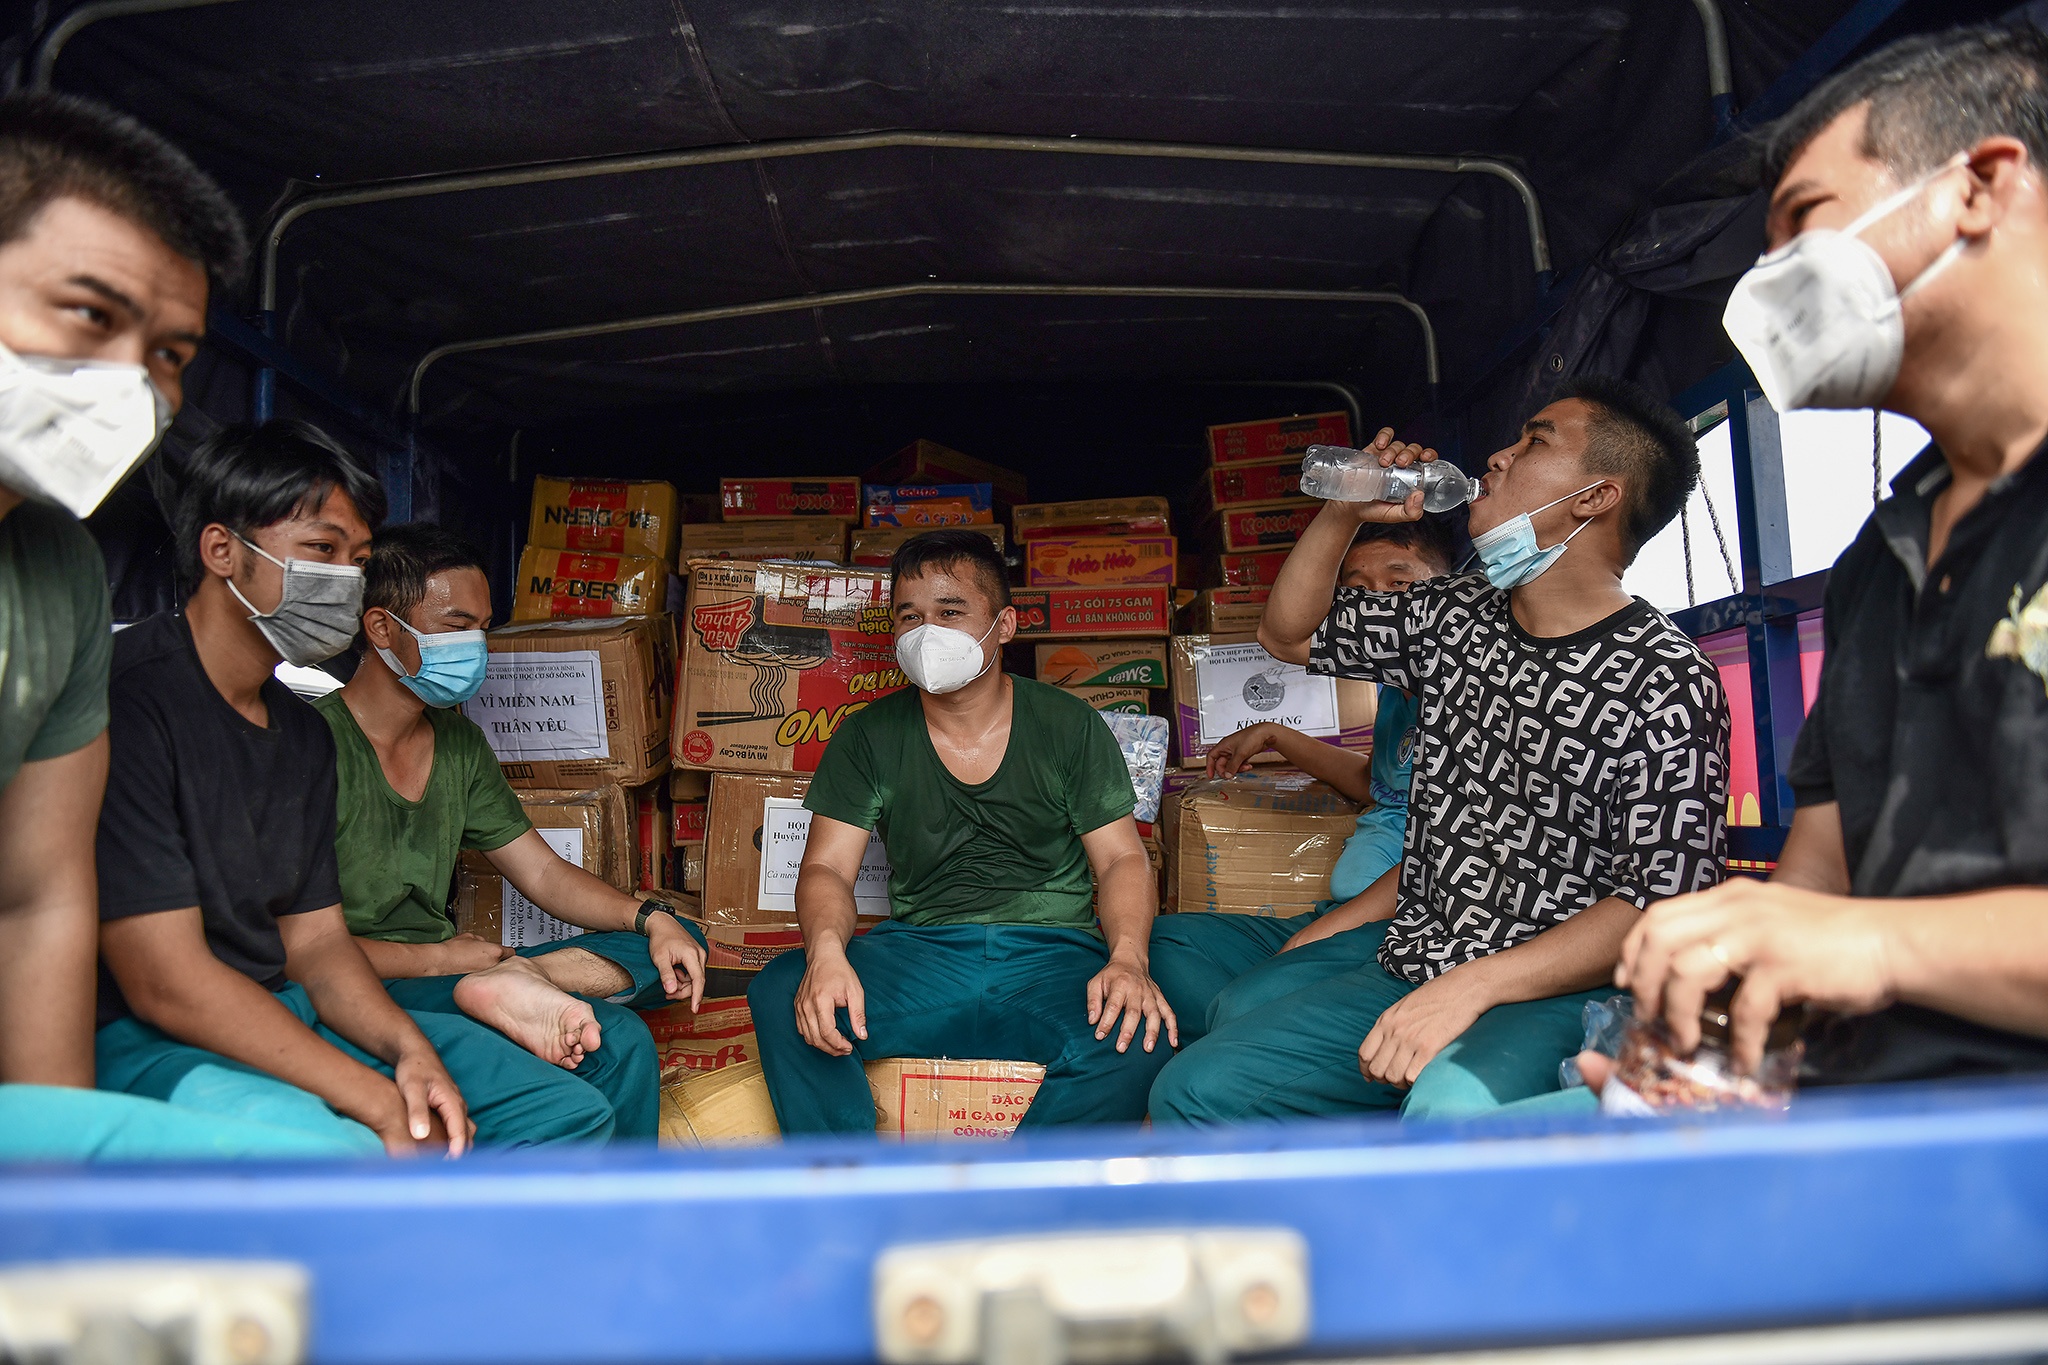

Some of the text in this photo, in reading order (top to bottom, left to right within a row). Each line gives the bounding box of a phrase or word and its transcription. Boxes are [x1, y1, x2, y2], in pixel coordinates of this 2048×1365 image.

[776, 493, 845, 511] KOKOMI
[1067, 548, 1137, 577] Hảo Hảo
[1064, 600, 1081, 610] 1,2
[1084, 596, 1105, 608] GÓI
[1108, 598, 1122, 607] 75
[1124, 596, 1153, 607] GAM
[699, 611, 749, 629] 4 phút
[862, 607, 887, 619] mới
[1066, 611, 1082, 624] GIÁ
[1085, 611, 1103, 623] BÁN
[1105, 610, 1137, 622] KHÔNG
[705, 628, 737, 647] Nấu
[1222, 656, 1237, 664] LIÊN
[519, 672, 534, 681] HỌC
[556, 670, 575, 679] SÔNG
[1089, 691, 1115, 702] CHUA
[1115, 689, 1132, 697] TÔM
[480, 694, 494, 708] VÌ
[540, 695, 576, 706] NAM
[492, 717, 567, 733] THÂN YÊU
[719, 748, 768, 761] Mì Vị Bò Cay
[788, 821, 805, 832] HỘI
[773, 832, 800, 842] Huyện
[1203, 843, 1220, 875] KIỆT
[517, 913, 524, 925] NỮ
[517, 925, 525, 940] PHỤ
[992, 1093, 1024, 1108] ĐẶC
[949, 1108, 967, 1120] MÌ
[971, 1110, 1006, 1124] GẠO
[954, 1125, 998, 1138] CÔNG
